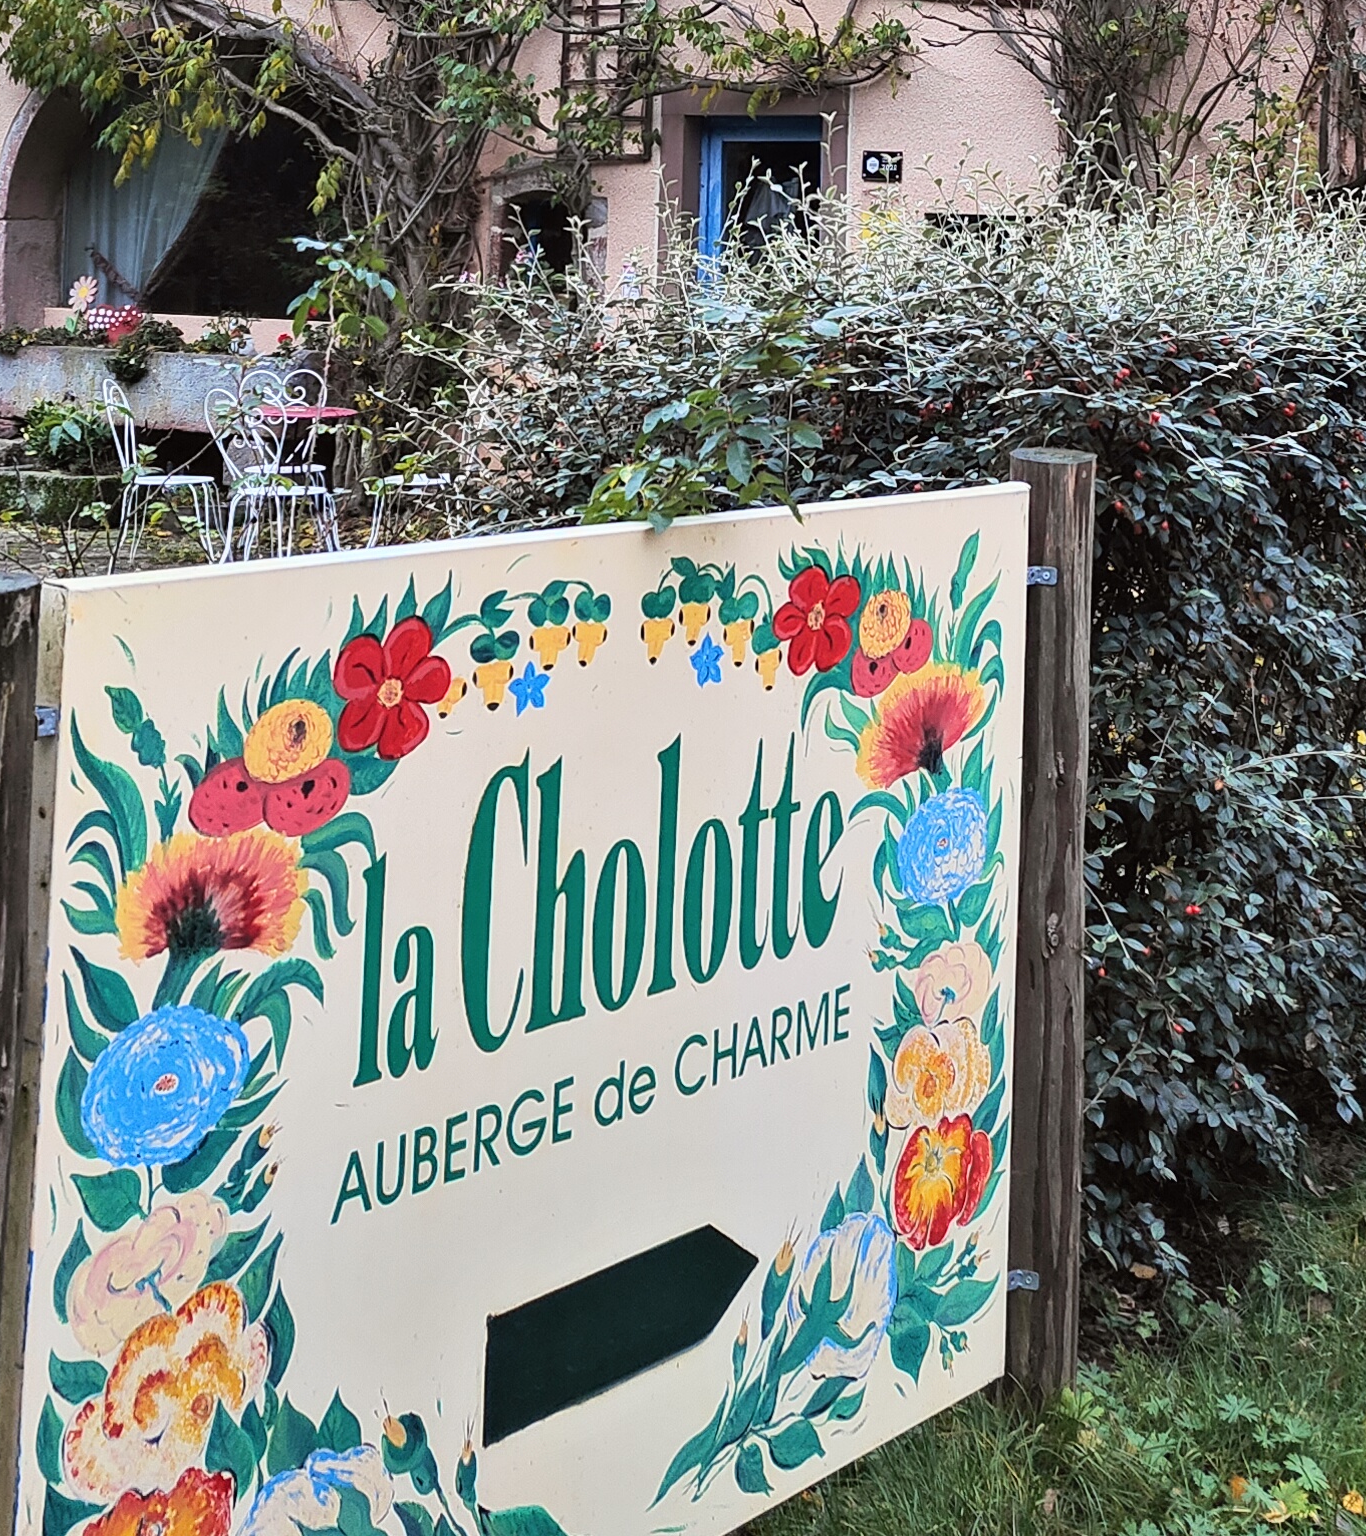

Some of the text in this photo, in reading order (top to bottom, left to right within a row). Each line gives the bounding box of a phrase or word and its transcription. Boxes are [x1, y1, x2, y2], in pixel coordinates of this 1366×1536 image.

[352, 731, 845, 1088] la Cholotte
[330, 983, 851, 1225] AUBERGE de CHARME
